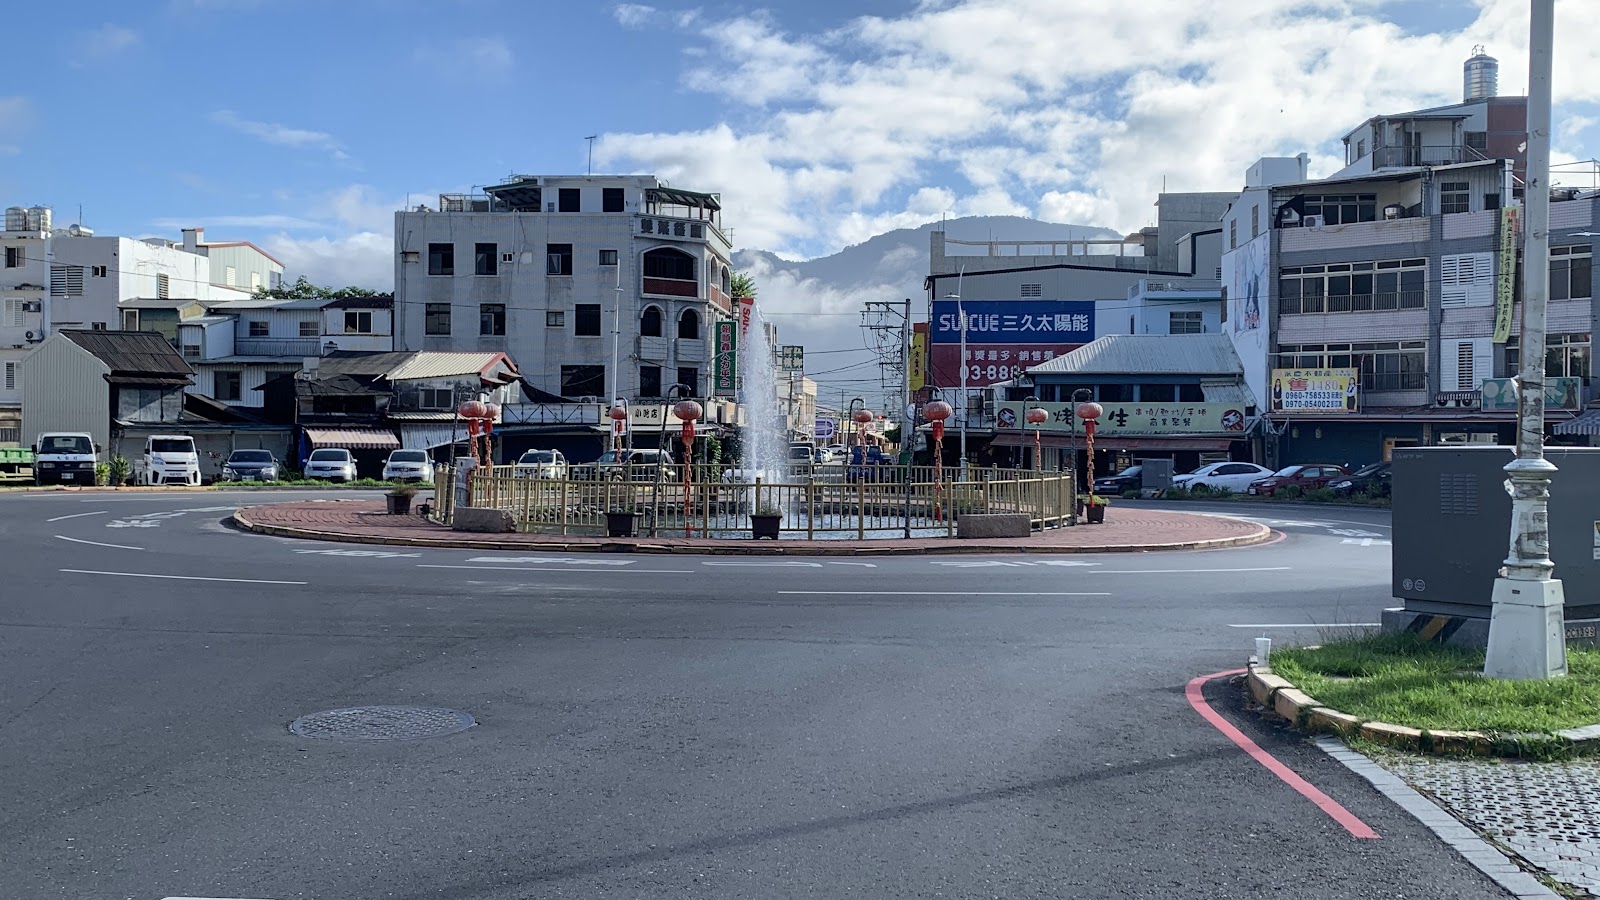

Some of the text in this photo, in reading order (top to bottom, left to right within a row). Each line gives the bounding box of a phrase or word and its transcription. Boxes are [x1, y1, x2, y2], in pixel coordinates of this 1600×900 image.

[939, 314, 1089, 332] SUCUE 三久太陽能
[1311, 380, 1338, 391] 1480
[1285, 400, 1331, 408] 0970-054002
